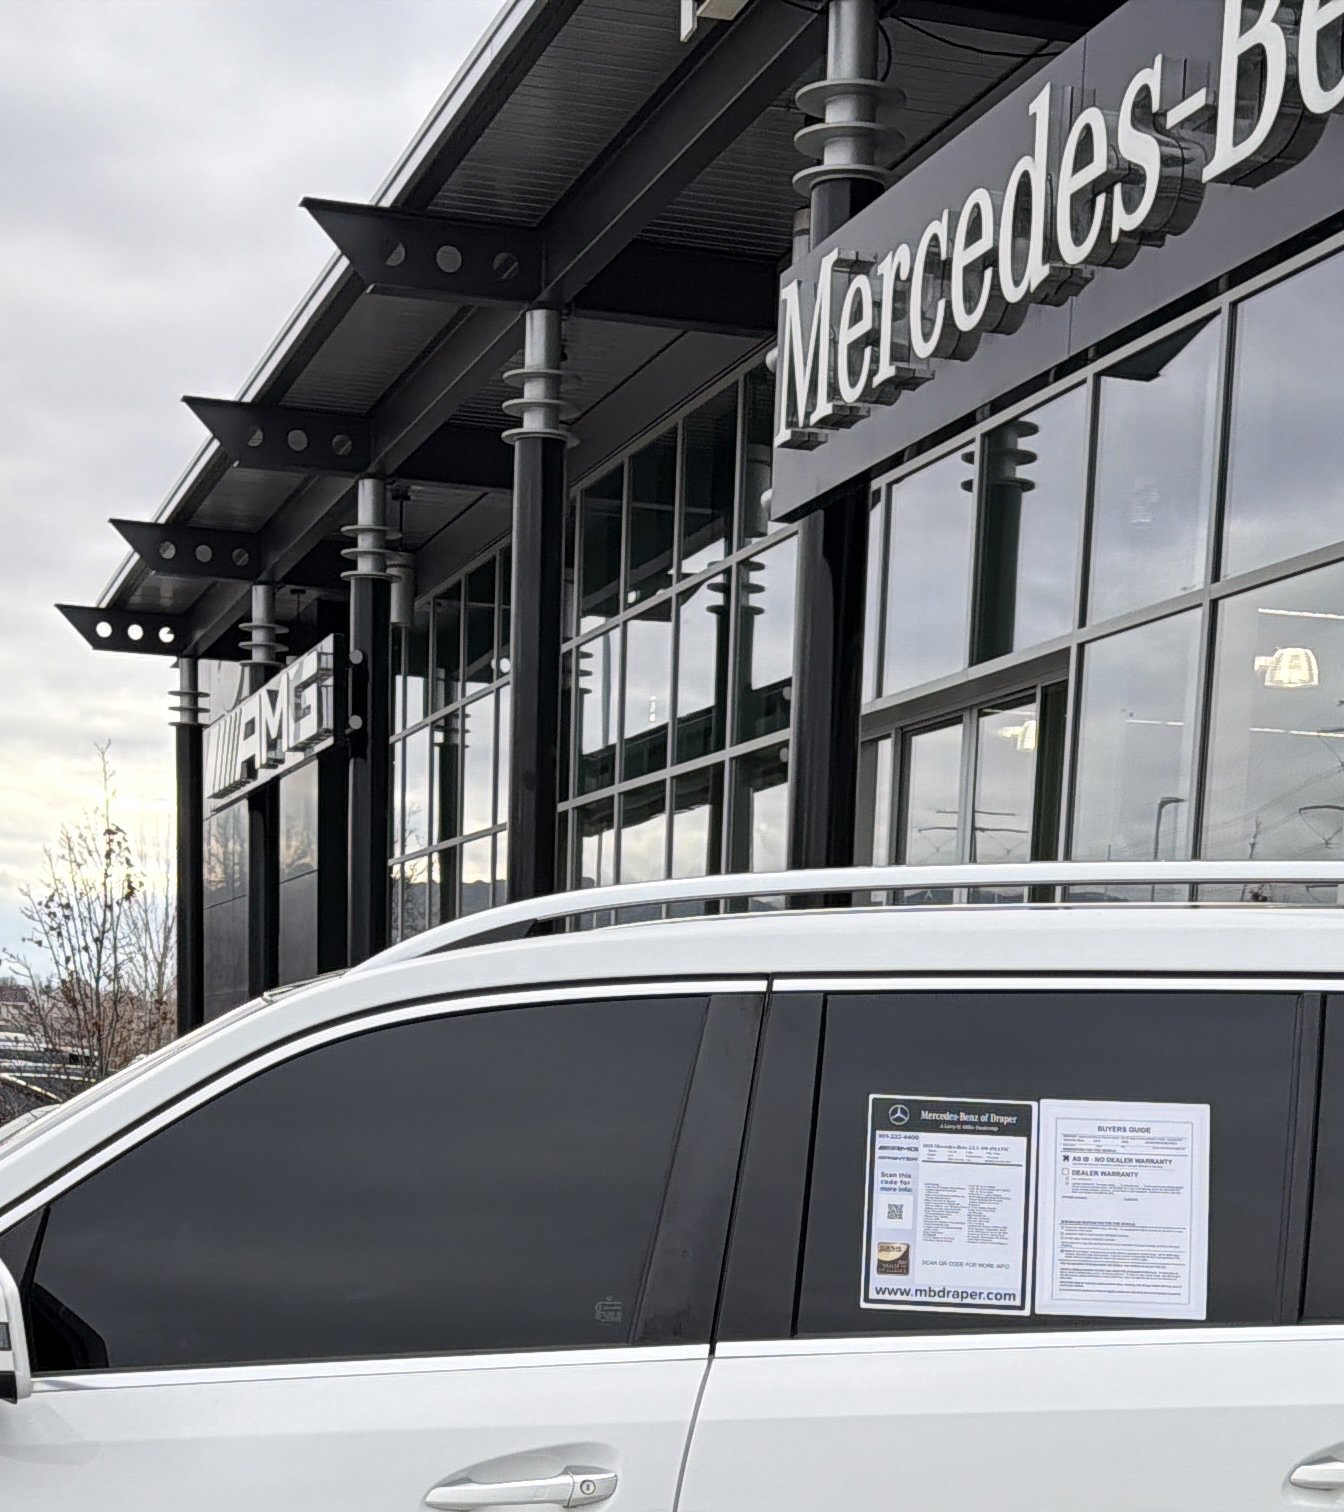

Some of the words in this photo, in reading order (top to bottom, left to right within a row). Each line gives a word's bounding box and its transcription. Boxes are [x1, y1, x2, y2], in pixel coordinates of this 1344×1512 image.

[920, 1110, 978, 1122] Mercedes-Benz
[980, 1112, 989, 1122] of
[990, 1113, 1018, 1126] Draper
[875, 1286, 1017, 1302] www.mbdraper.com
